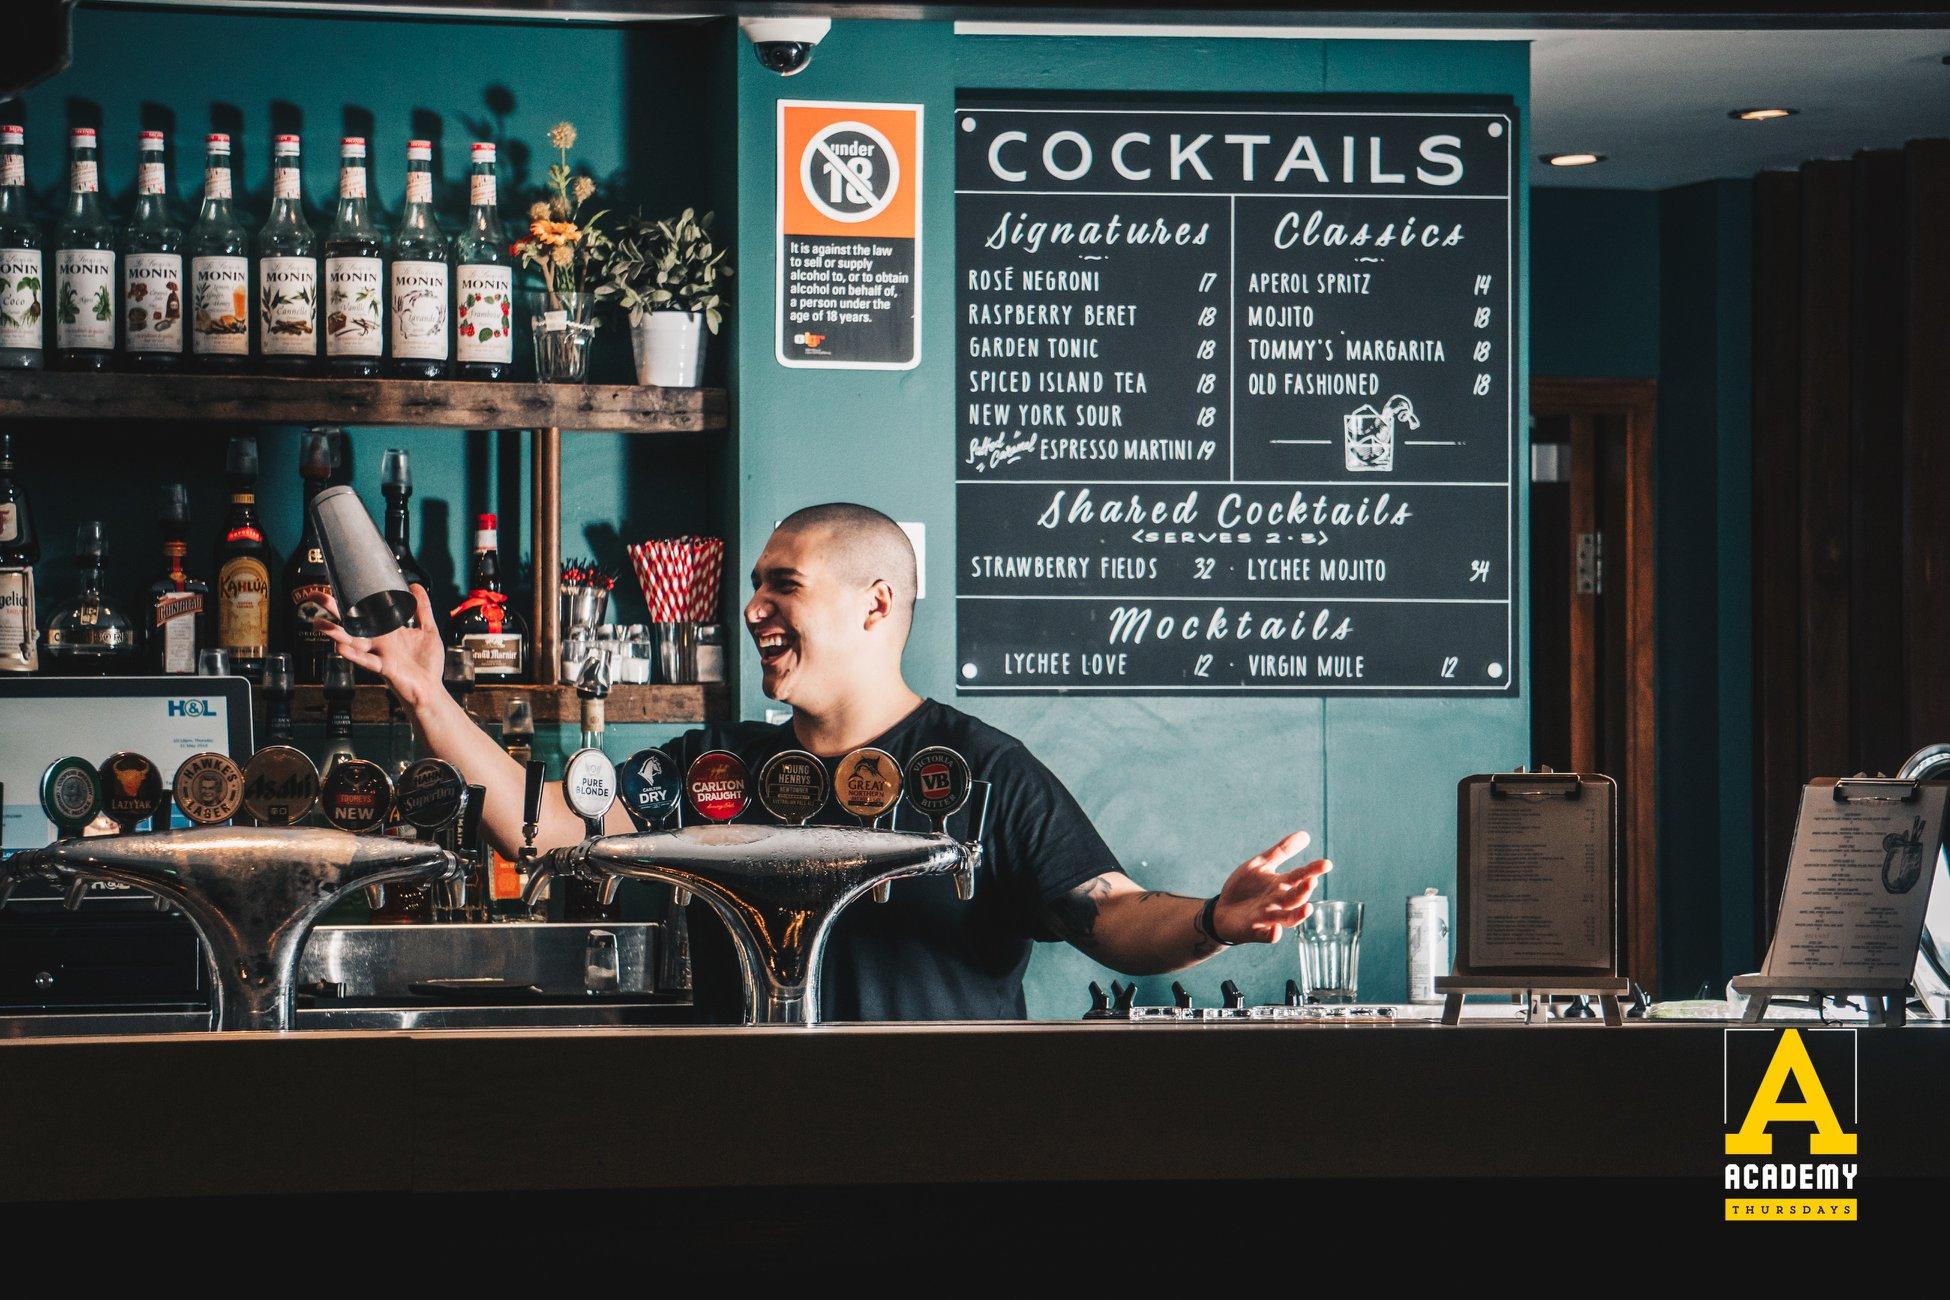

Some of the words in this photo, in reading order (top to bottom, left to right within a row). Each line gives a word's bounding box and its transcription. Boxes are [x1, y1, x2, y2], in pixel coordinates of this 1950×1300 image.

[830, 140, 875, 157] under
[989, 131, 1464, 186] COCKTAILS
[823, 157, 873, 204] 18
[985, 211, 1210, 254] Signatures
[1274, 210, 1465, 250] Classics
[791, 242, 800, 254] It
[801, 243, 810, 254] is
[812, 243, 851, 257] against
[853, 244, 870, 256] the
[873, 245, 892, 257] law
[0, 264, 38, 275] ONIN
[60, 264, 109, 275] MONIN
[790, 257, 802, 268] to
[804, 257, 823, 268] sell
[825, 259, 836, 269] or
[838, 259, 873, 272] supply
[129, 268, 178, 279] MONIN
[198, 270, 246, 281] MONIN
[266, 272, 313, 282] MONIN
[330, 272, 377, 283] MONIN
[396, 276, 443, 287] MONIN
[790, 271, 830, 282] alcohol
[832, 272, 847, 285] to,
[848, 273, 860, 283] or
[862, 273, 874, 283] to
[875, 272, 909, 284] obtain
[969, 266, 1014, 292] ROSÉ
[1023, 271, 1100, 292] NEGRONI
[1198, 273, 1218, 293] 17
[462, 279, 509, 290] MONIN
[790, 284, 830, 295] alcohol
[832, 286, 846, 296] on
[848, 285, 882, 297] behalf
[884, 286, 898, 299] of,
[1248, 272, 1309, 294] APEROL
[1317, 273, 1371, 295] SPRITZ
[1474, 275, 1492, 296] 14
[790, 299, 797, 308] a
[799, 299, 838, 313] person
[840, 298, 871, 310] under
[873, 299, 891, 310] the
[790, 312, 809, 325] age
[812, 311, 824, 322] of
[826, 311, 838, 322] 18
[839, 311, 872, 325] years.
[969, 304, 1073, 326] RASPBERRY
[1085, 305, 1138, 327] BERET
[1197, 307, 1217, 327] 18
[1248, 306, 1314, 328] MOJITO
[1473, 307, 1491, 329] 18
[969, 337, 1039, 358] GARDEN
[1047, 338, 1099, 359] TONIC
[1197, 339, 1217, 360] 18
[1248, 339, 1334, 362] TOMMY'S
[1346, 340, 1445, 362] MARGARITA
[1473, 341, 1492, 362] 18
[969, 371, 1031, 393] SPICED
[1039, 372, 1104, 394] ISLAND
[1114, 373, 1147, 394] TEA
[1197, 374, 1217, 395] 18
[1248, 373, 1277, 395] OLD
[1284, 373, 1379, 396] FASHIONED
[1473, 374, 1492, 396] 18
[969, 404, 1010, 426] NEW
[1019, 404, 1066, 427] YORK
[1077, 405, 1122, 428] SOUR
[1197, 407, 1217, 428] 18
[1040, 438, 1119, 461] ESPRESSO
[1124, 439, 1193, 461] MARTINI
[1196, 439, 1217, 461] 19
[1037, 487, 1199, 529] Shared
[1217, 490, 1413, 529] Cocktails
[971, 555, 1089, 579] STRAWBERRY
[1101, 557, 1158, 580] FIELDS
[1193, 558, 1216, 580] 32
[1248, 558, 1311, 581] LYCHEE
[1320, 559, 1386, 582] MOJITO
[1469, 560, 1490, 583] 34
[220, 575, 268, 599] KAHLÚA
[1109, 606, 1354, 645] Mocktails
[473, 649, 490, 659] rand
[1004, 653, 1070, 675] LYCHEE
[1082, 654, 1128, 676] LOVE
[1194, 654, 1214, 678] 12
[1248, 655, 1307, 678] VIRGIN
[1318, 656, 1364, 678] MULE
[1441, 657, 1459, 678] 12
[168, 699, 217, 717] H&L
[183, 758, 238, 782] HAWKE'S
[782, 764, 810, 775] YOUNG
[913, 754, 954, 772] VICTORIA
[582, 777, 603, 788] PURE
[692, 779, 745, 793] CARLTON
[778, 774, 811, 785] HENRYS
[848, 779, 885, 790] GREAT
[922, 773, 949, 790] VB
[576, 785, 609, 797] BLONDE
[640, 789, 667, 804] DRY
[697, 790, 742, 803] DRAUGHT
[186, 799, 231, 818] LAGER
[335, 807, 374, 820] NEW
